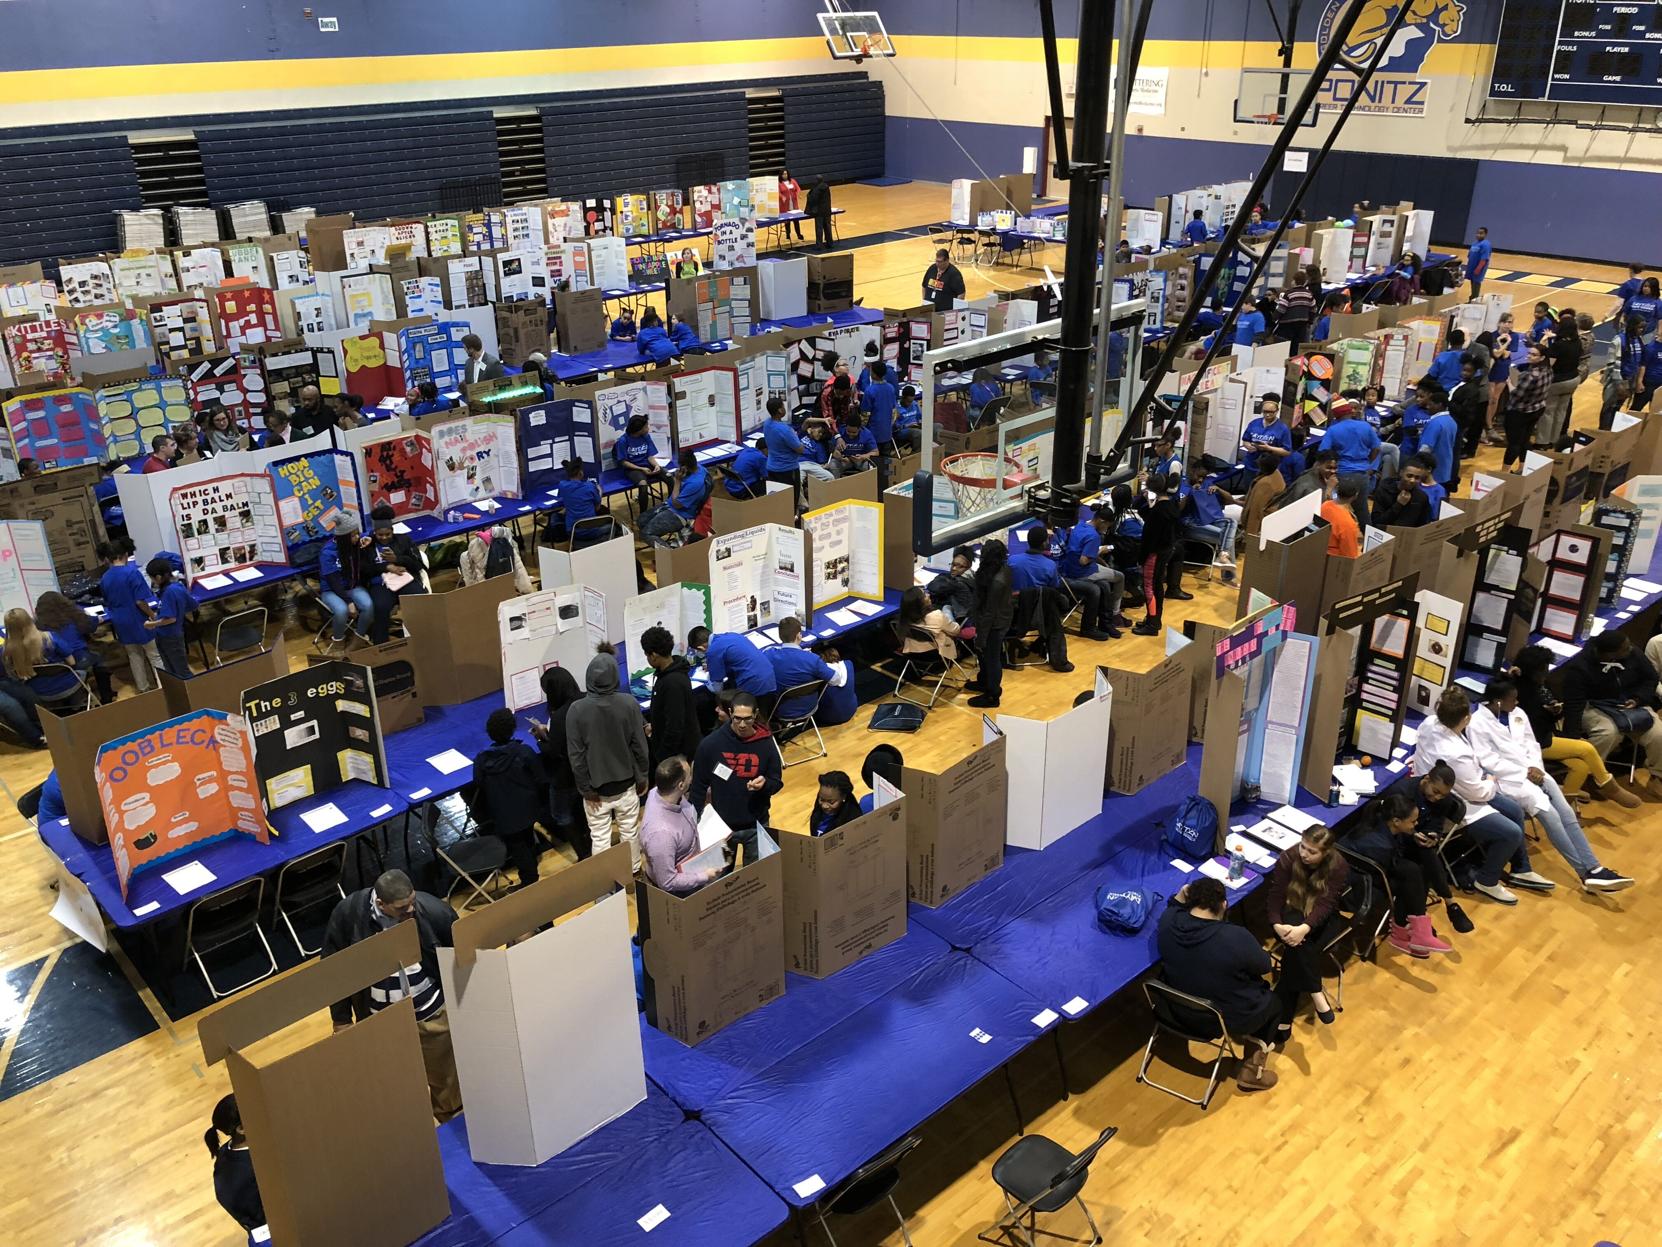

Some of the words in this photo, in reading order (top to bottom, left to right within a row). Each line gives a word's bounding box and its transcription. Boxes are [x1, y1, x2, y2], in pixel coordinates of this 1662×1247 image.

[320, 19, 337, 30] Away
[1605, 46, 1630, 54] PLAYER
[1340, 105, 1389, 113] THNOLOGY
[1391, 106, 1424, 115] CENTER
[714, 221, 740, 233] TORNADO
[717, 237, 738, 246] BOTTLE
[438, 424, 468, 440] DOES
[459, 431, 499, 455] POLISH
[278, 457, 310, 478] HOW
[288, 469, 314, 486] BIG
[180, 486, 220, 500] WHICH
[294, 476, 321, 497] CAN
[181, 500, 199, 511] LIP
[202, 492, 233, 506] BALM
[305, 494, 313, 505] I
[181, 513, 192, 522] IS
[202, 507, 218, 517] DA
[222, 500, 249, 513] BALM
[303, 499, 325, 521] GET
[716, 531, 746, 547] Expanding
[745, 526, 766, 536] Liquids
[246, 697, 282, 718] The
[287, 691, 298, 706] 3
[307, 681, 345, 698] eggs
